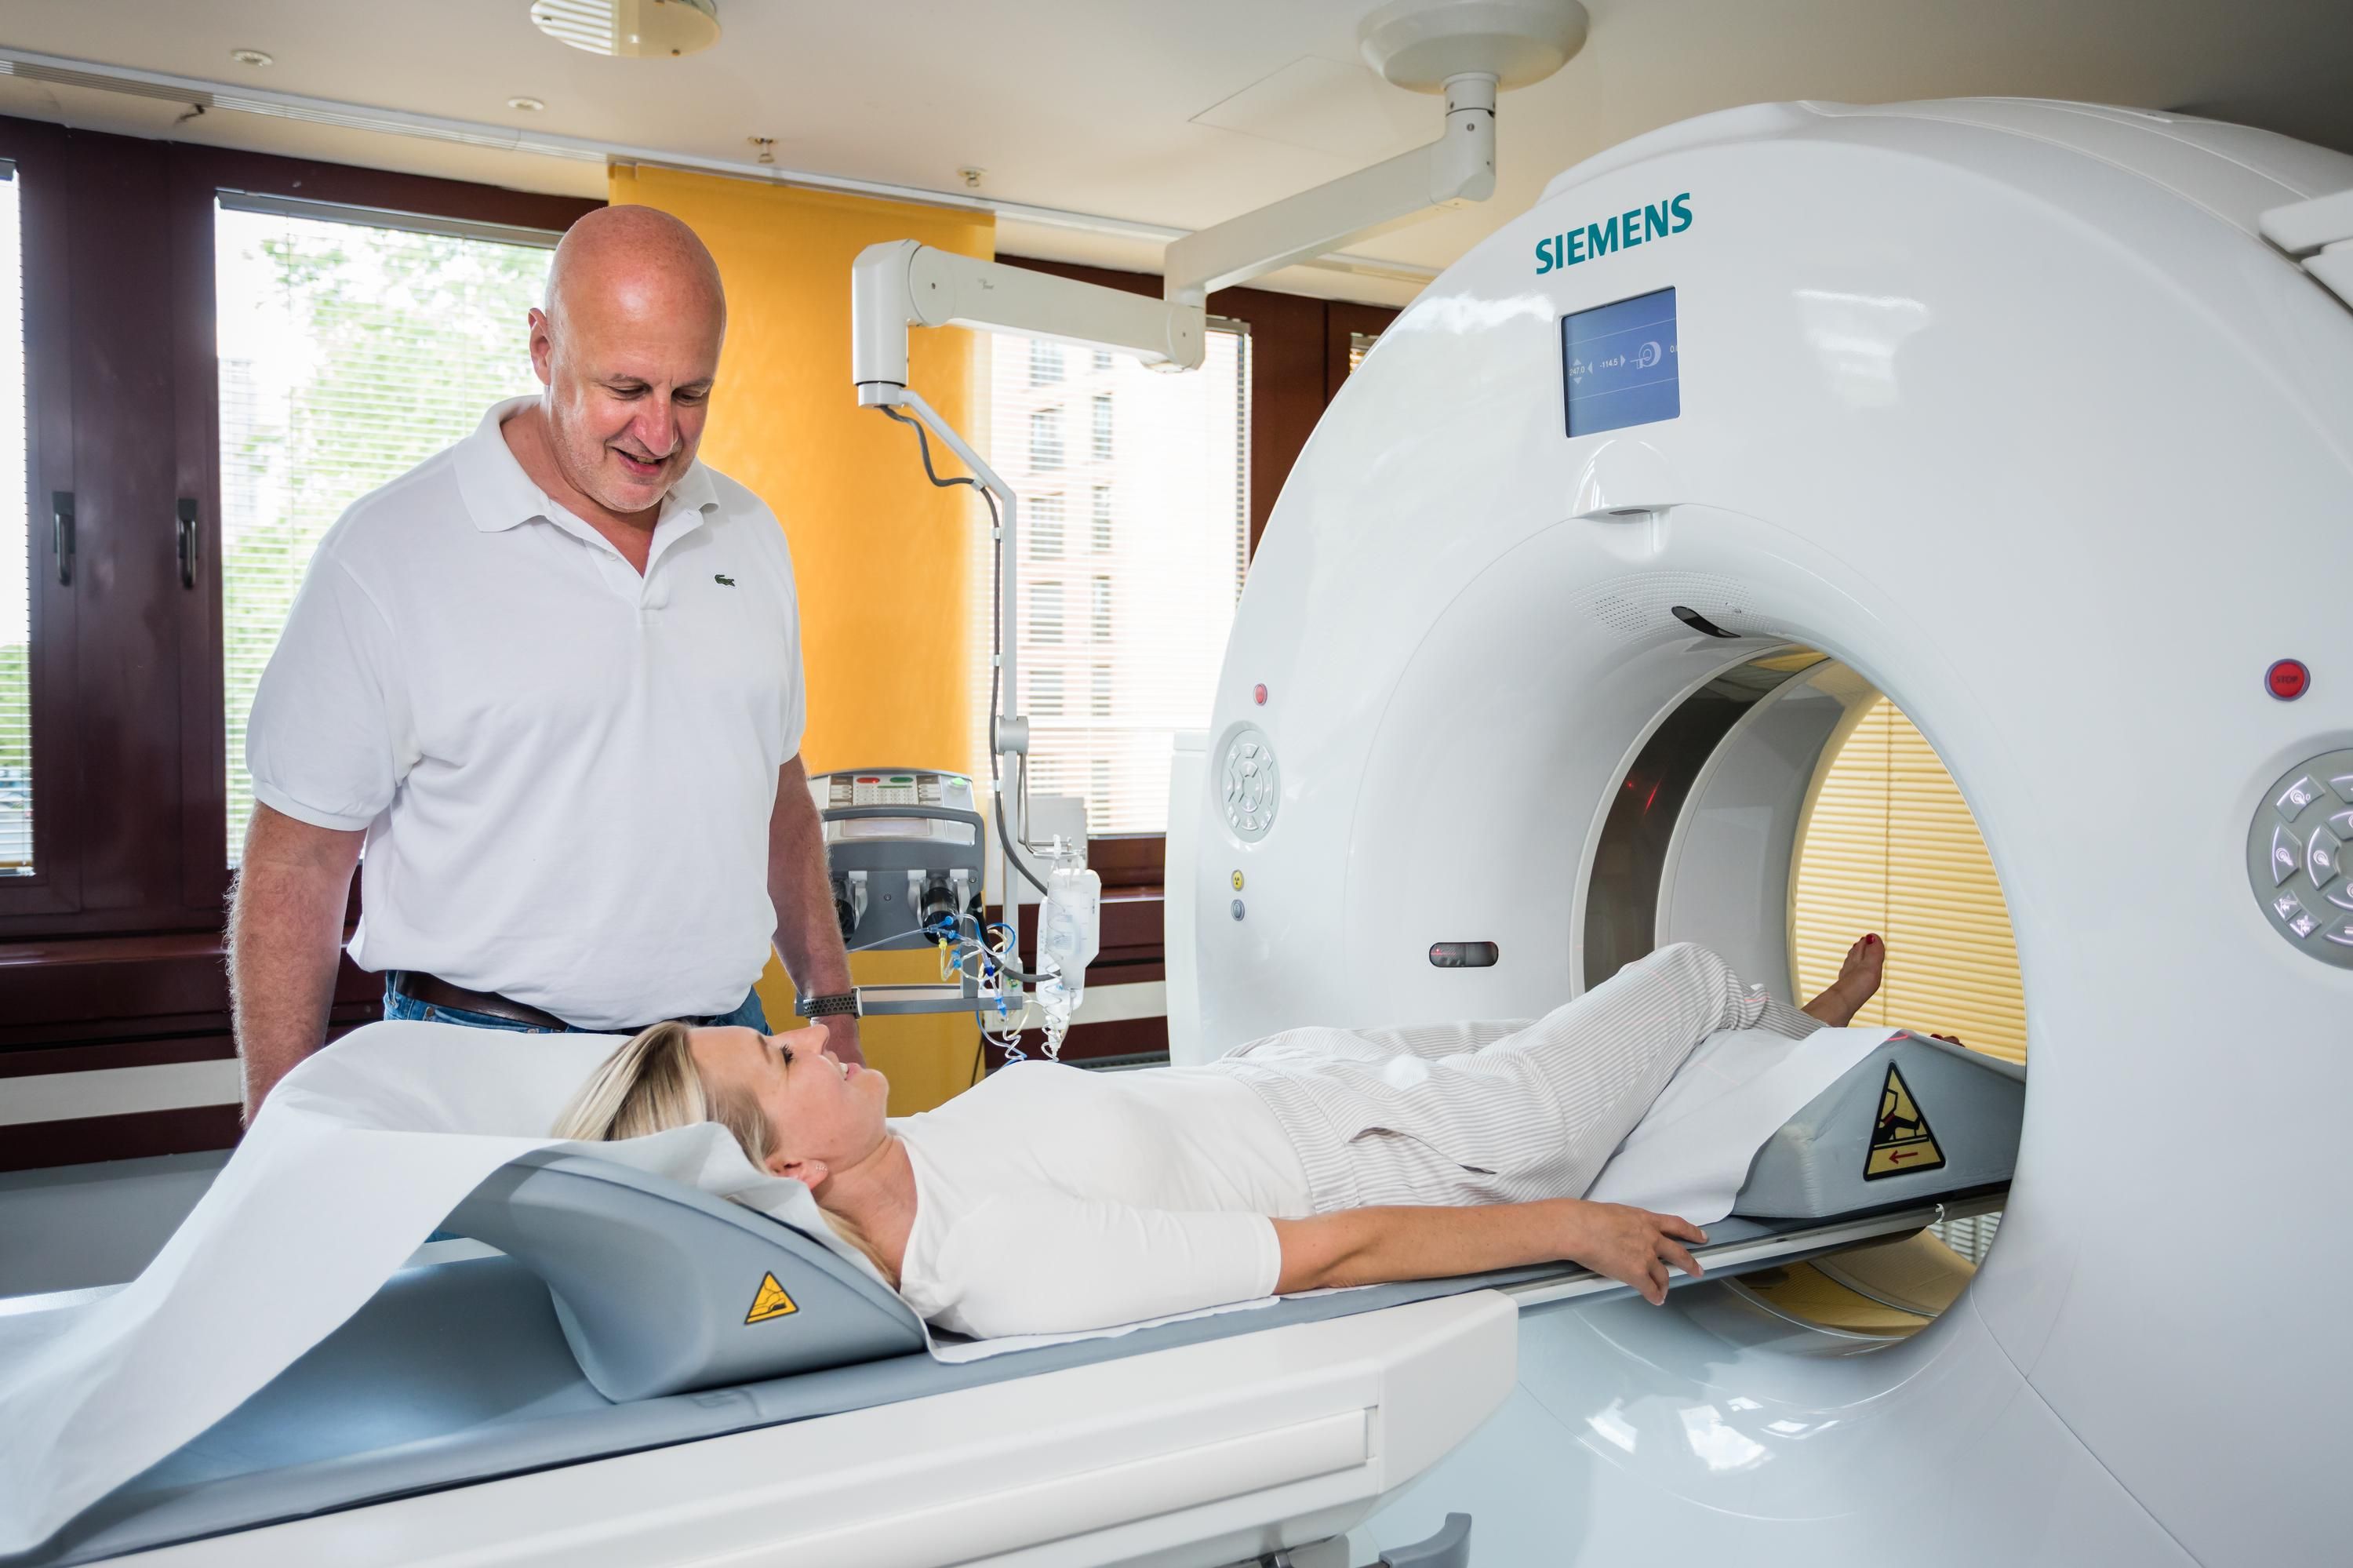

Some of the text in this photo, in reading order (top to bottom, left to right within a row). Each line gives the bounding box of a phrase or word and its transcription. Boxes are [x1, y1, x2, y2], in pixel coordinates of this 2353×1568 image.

[1535, 192, 1693, 275] SIEMENS
[1599, 358, 1618, 369] -114.5
[1569, 366, 1585, 377] 247.0
